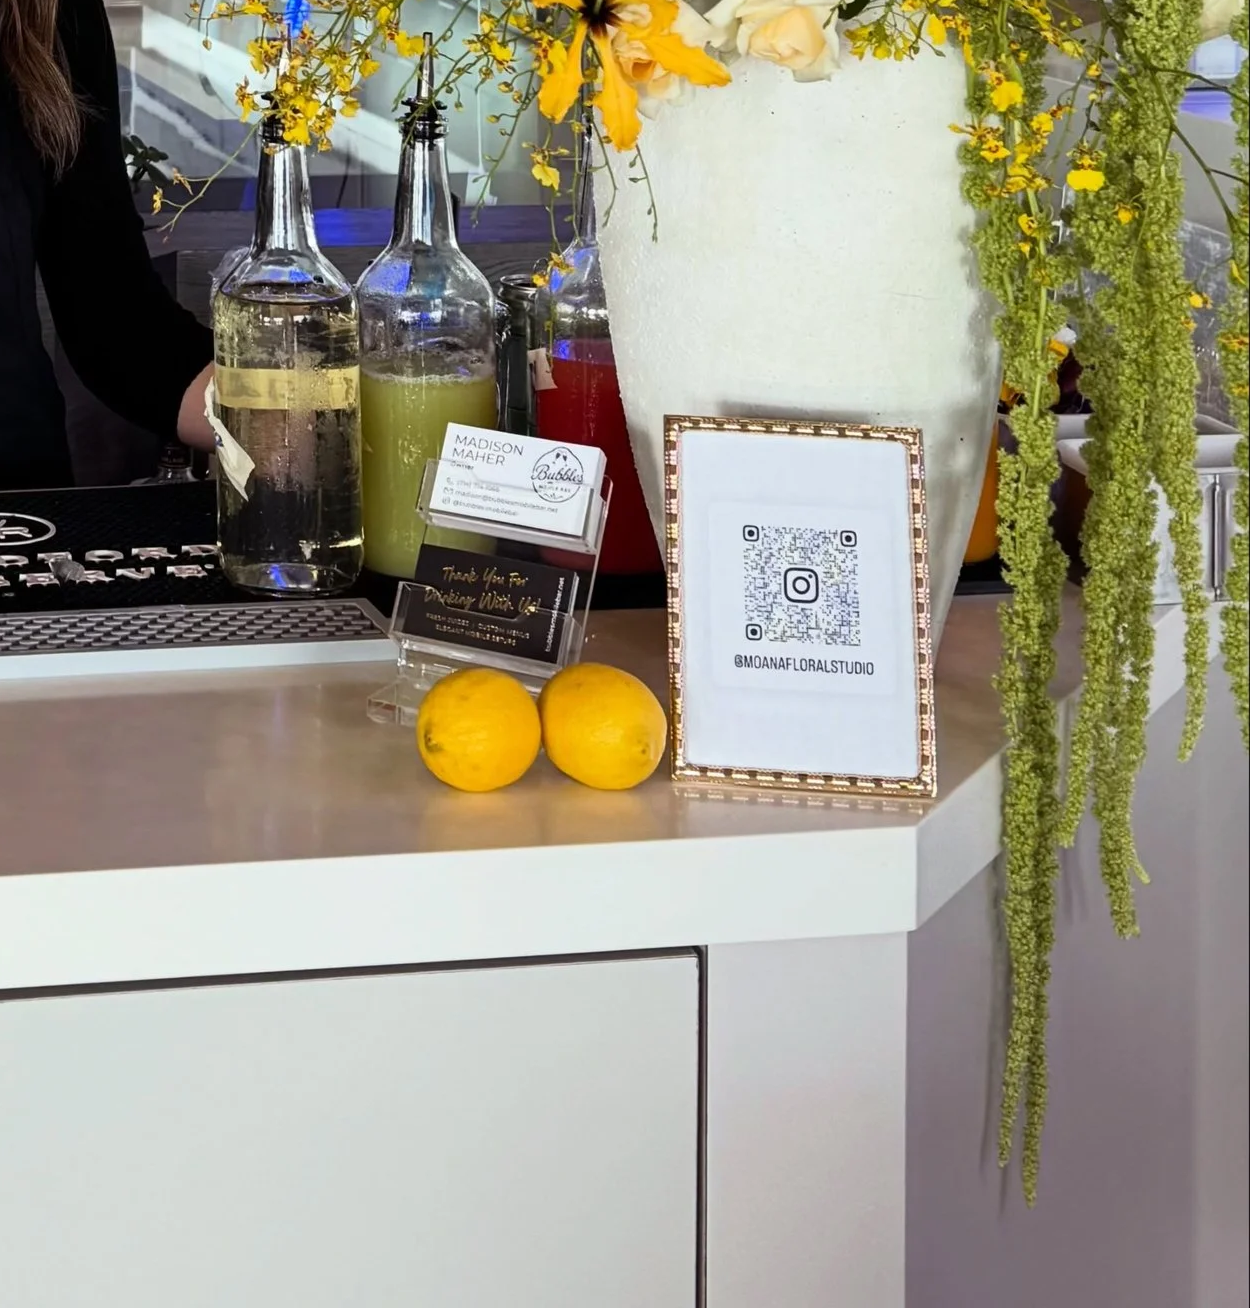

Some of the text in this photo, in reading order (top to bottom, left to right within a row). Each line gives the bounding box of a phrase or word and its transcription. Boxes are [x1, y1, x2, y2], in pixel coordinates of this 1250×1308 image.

[455, 434, 524, 456] MADISON
[452, 448, 505, 466] MAHER
[531, 464, 584, 484] Bubbles
[443, 565, 529, 590] Thank You For
[424, 587, 476, 611] Drinking
[479, 591, 513, 611] With
[734, 654, 874, 676] @MOANAFLORALSTUDIO
